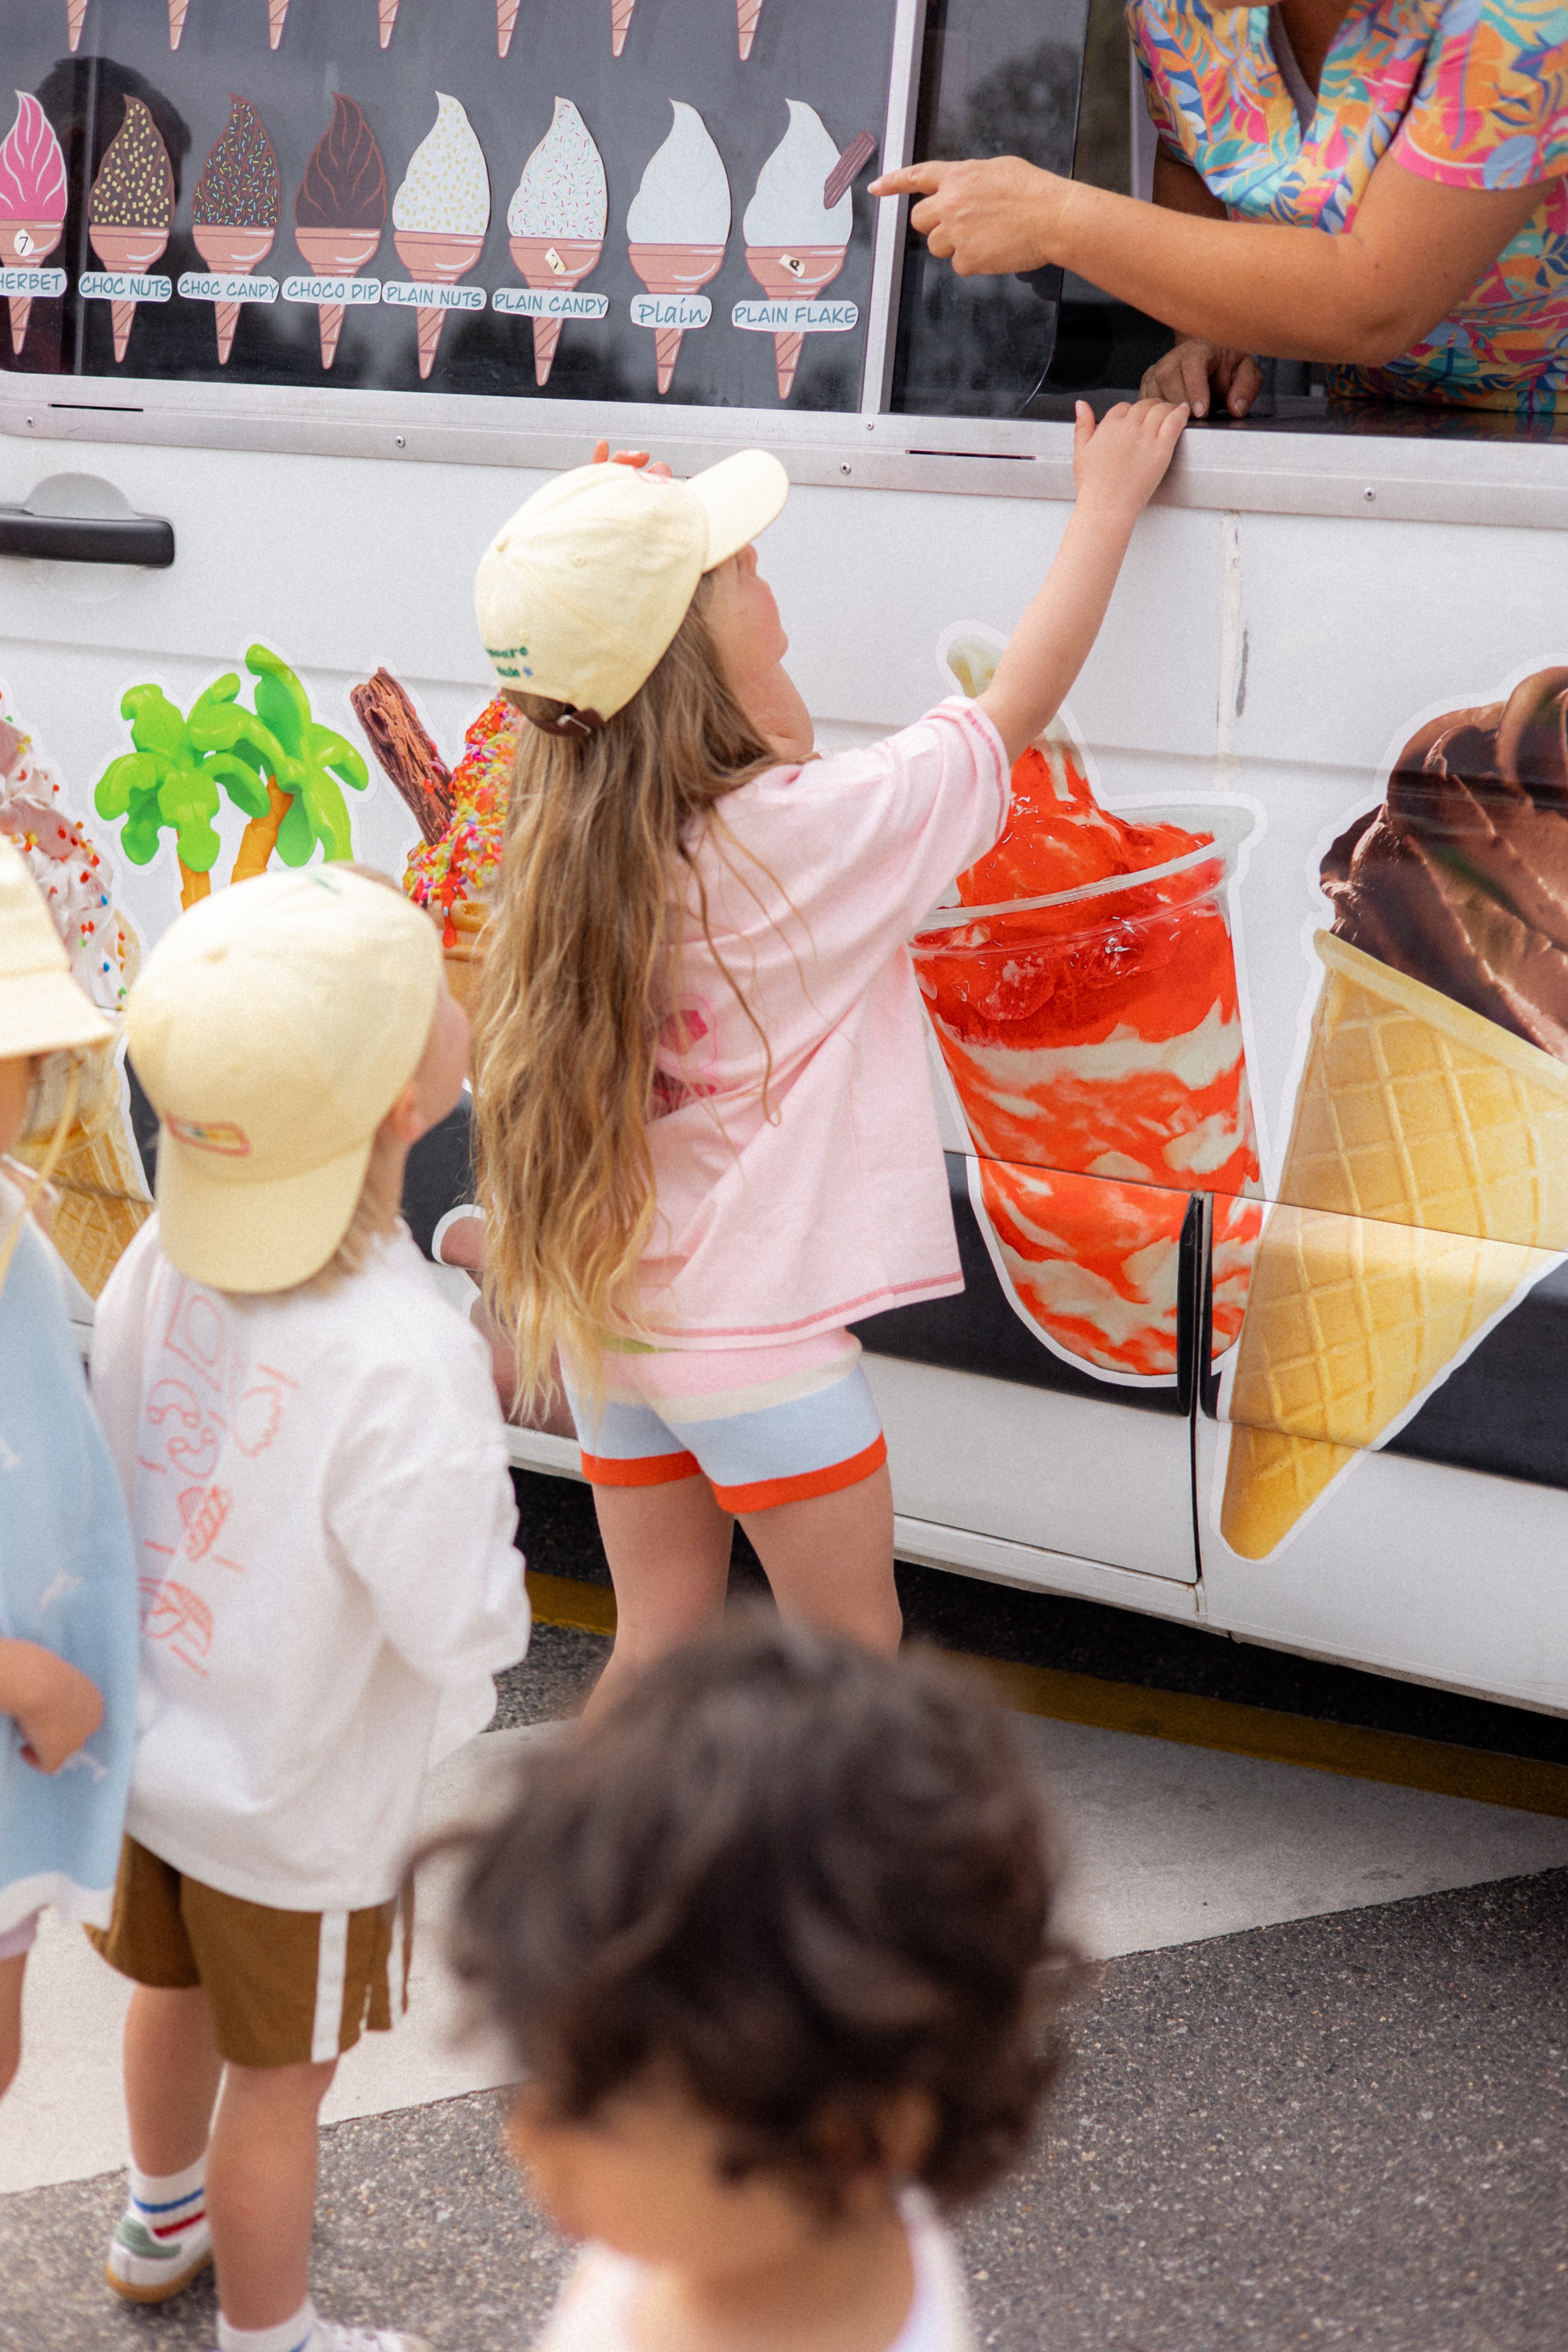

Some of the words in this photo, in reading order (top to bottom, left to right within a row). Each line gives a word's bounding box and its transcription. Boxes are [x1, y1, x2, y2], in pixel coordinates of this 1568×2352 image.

[19, 236, 28, 254] 7
[81, 276, 126, 295] CHOC
[130, 279, 171, 297] NUTS
[180, 279, 221, 295] CHOC
[227, 282, 279, 298] CANDY
[288, 282, 345, 299] CHOCO
[352, 284, 379, 300] DIP
[387, 287, 434, 304] PLAIN
[440, 291, 482, 308] NUTS
[495, 294, 542, 310] PLAIN
[548, 297, 607, 314] CANDY
[639, 298, 707, 324] Plain
[735, 307, 787, 323] PLAIN
[795, 307, 855, 324] FLAKE
